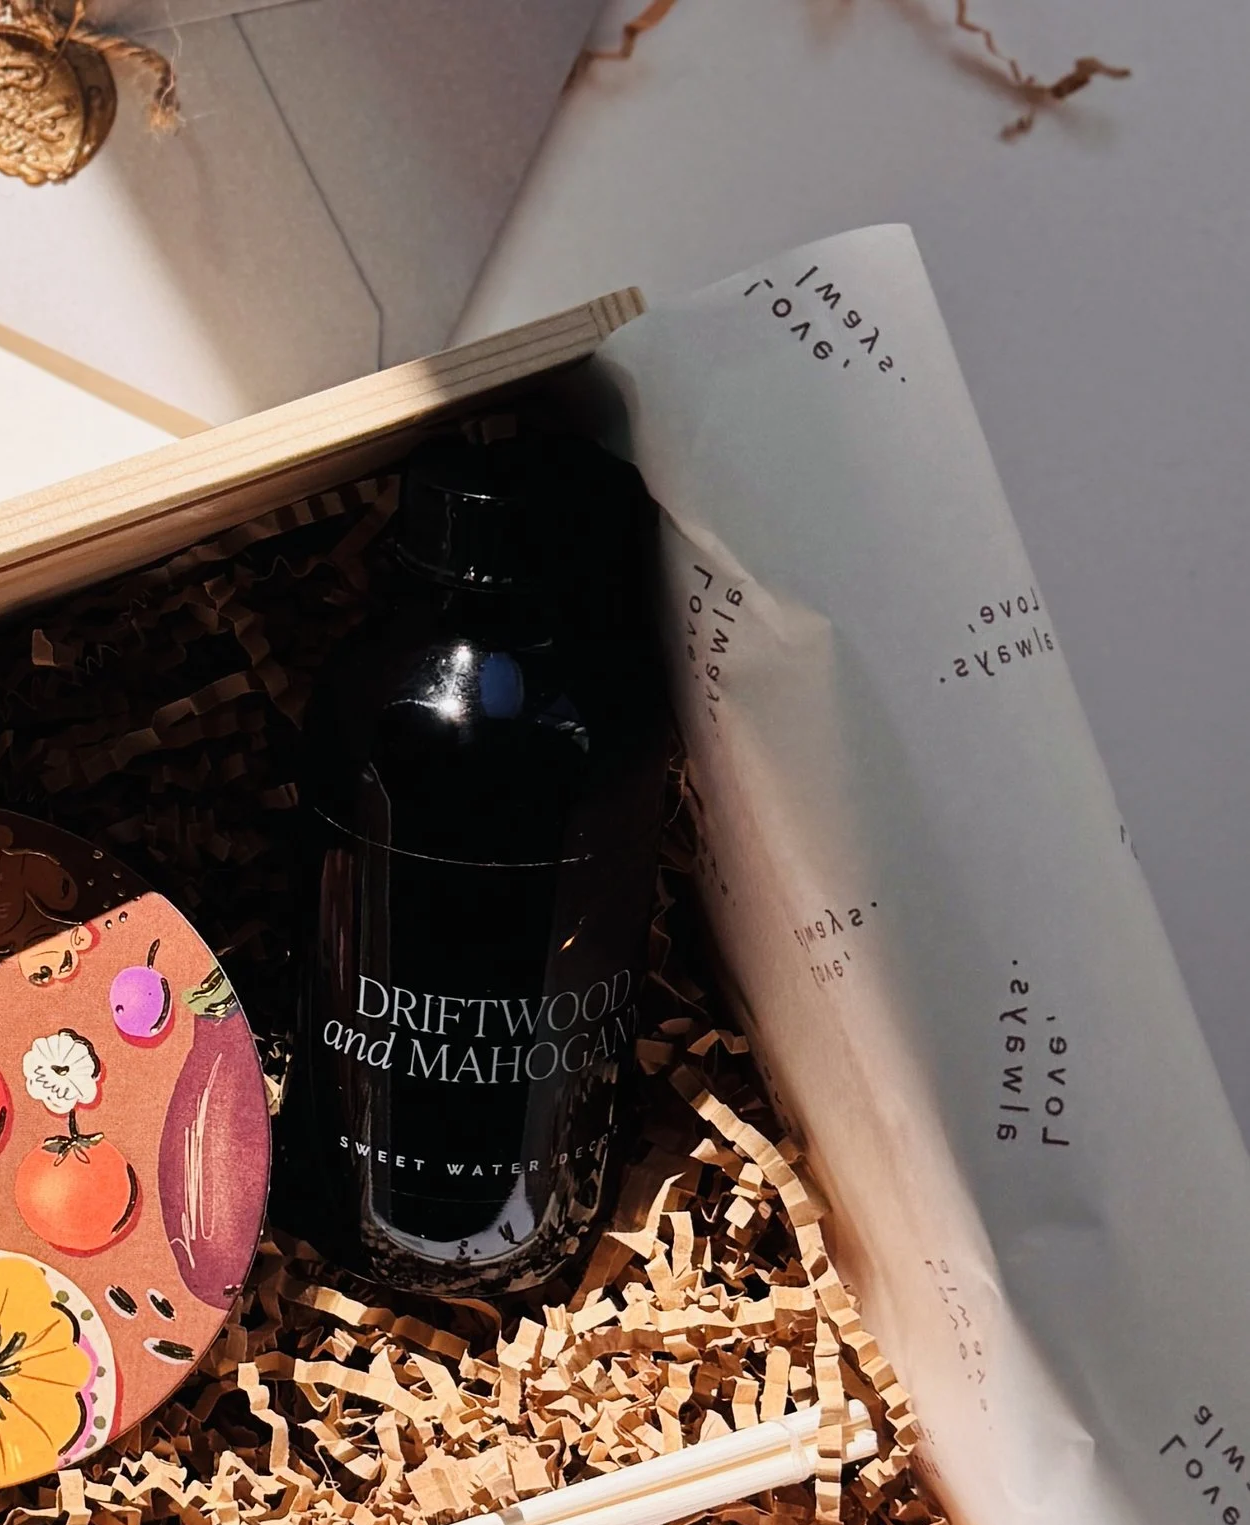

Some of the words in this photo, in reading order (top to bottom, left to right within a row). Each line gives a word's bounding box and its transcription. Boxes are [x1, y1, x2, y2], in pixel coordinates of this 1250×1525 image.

[356, 969, 631, 1038] DRIFTWOOD
[323, 1019, 397, 1070] and
[406, 1004, 638, 1084] MAHOGAN
[340, 1135, 425, 1171] SWEET
[446, 1158, 540, 1177] WATER
